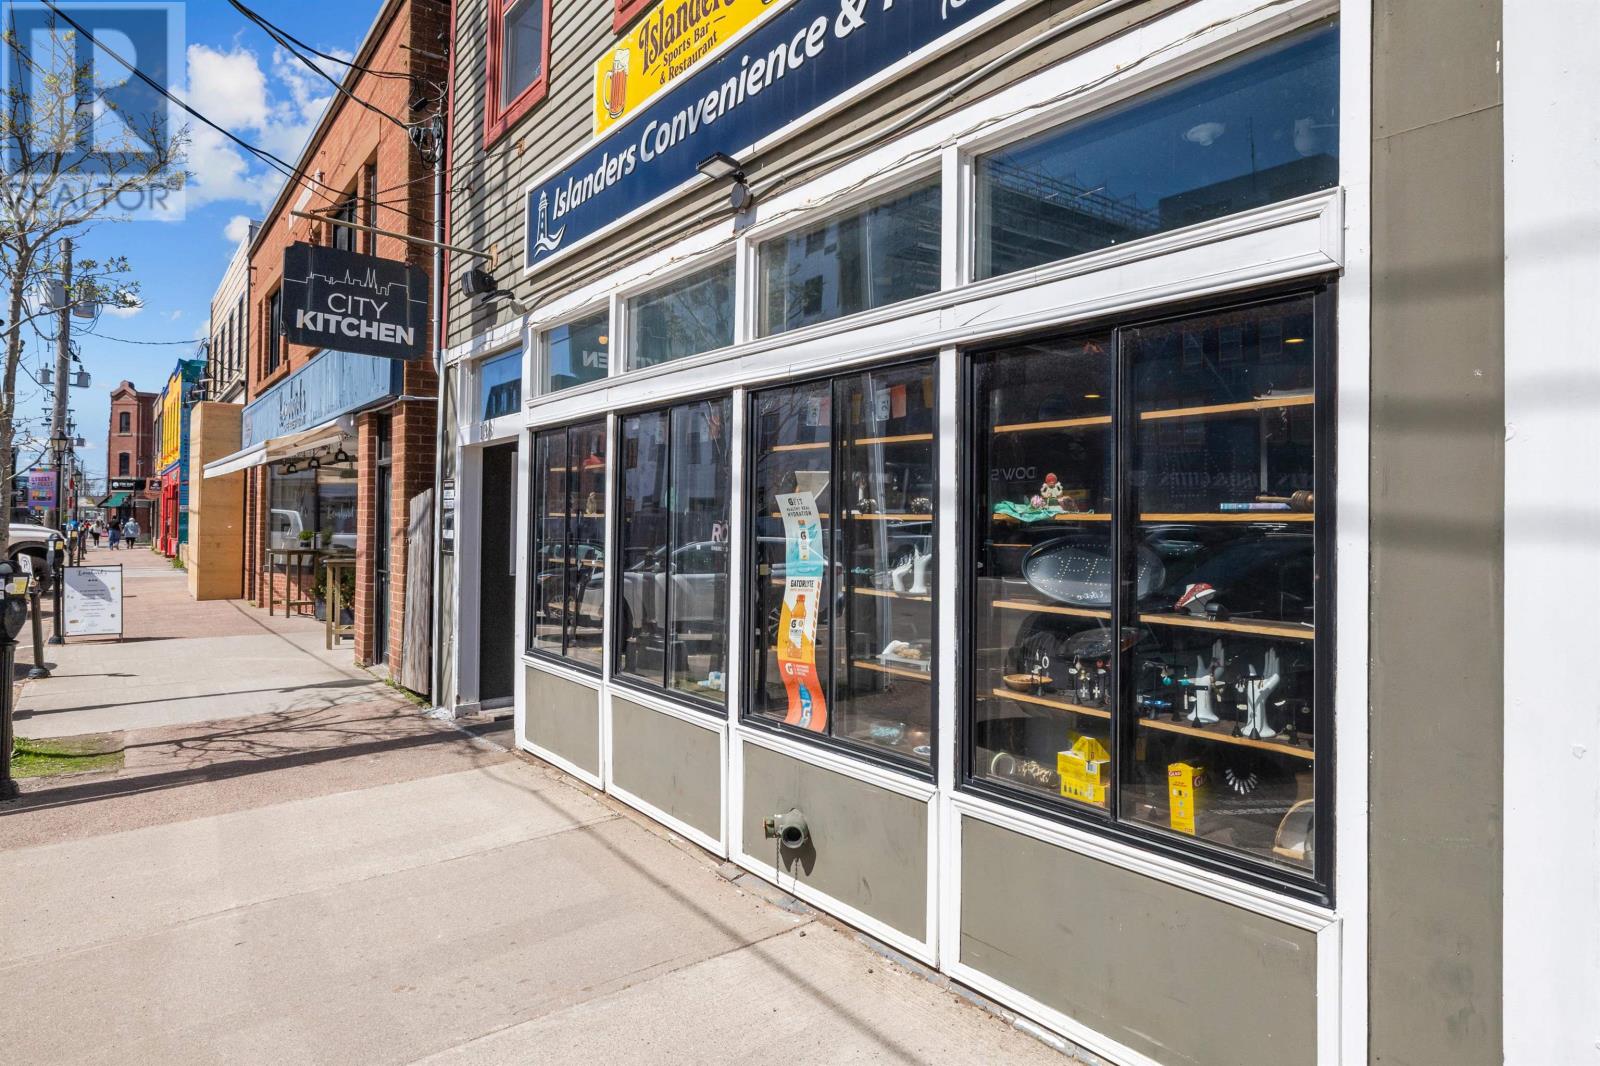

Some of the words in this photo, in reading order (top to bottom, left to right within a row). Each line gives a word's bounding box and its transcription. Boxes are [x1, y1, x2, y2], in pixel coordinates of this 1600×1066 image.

[659, 72, 666, 85] &
[668, 30, 718, 81] Restaurant
[663, 38, 691, 68] Sports
[693, 22, 710, 45] Bar
[552, 143, 638, 221] Islanders
[640, 15, 828, 163] Convenience
[834, 0, 867, 38] &
[296, 308, 415, 346] KITCHEN
[327, 293, 389, 319] CITY
[790, 580, 814, 588] GATORLYTE
